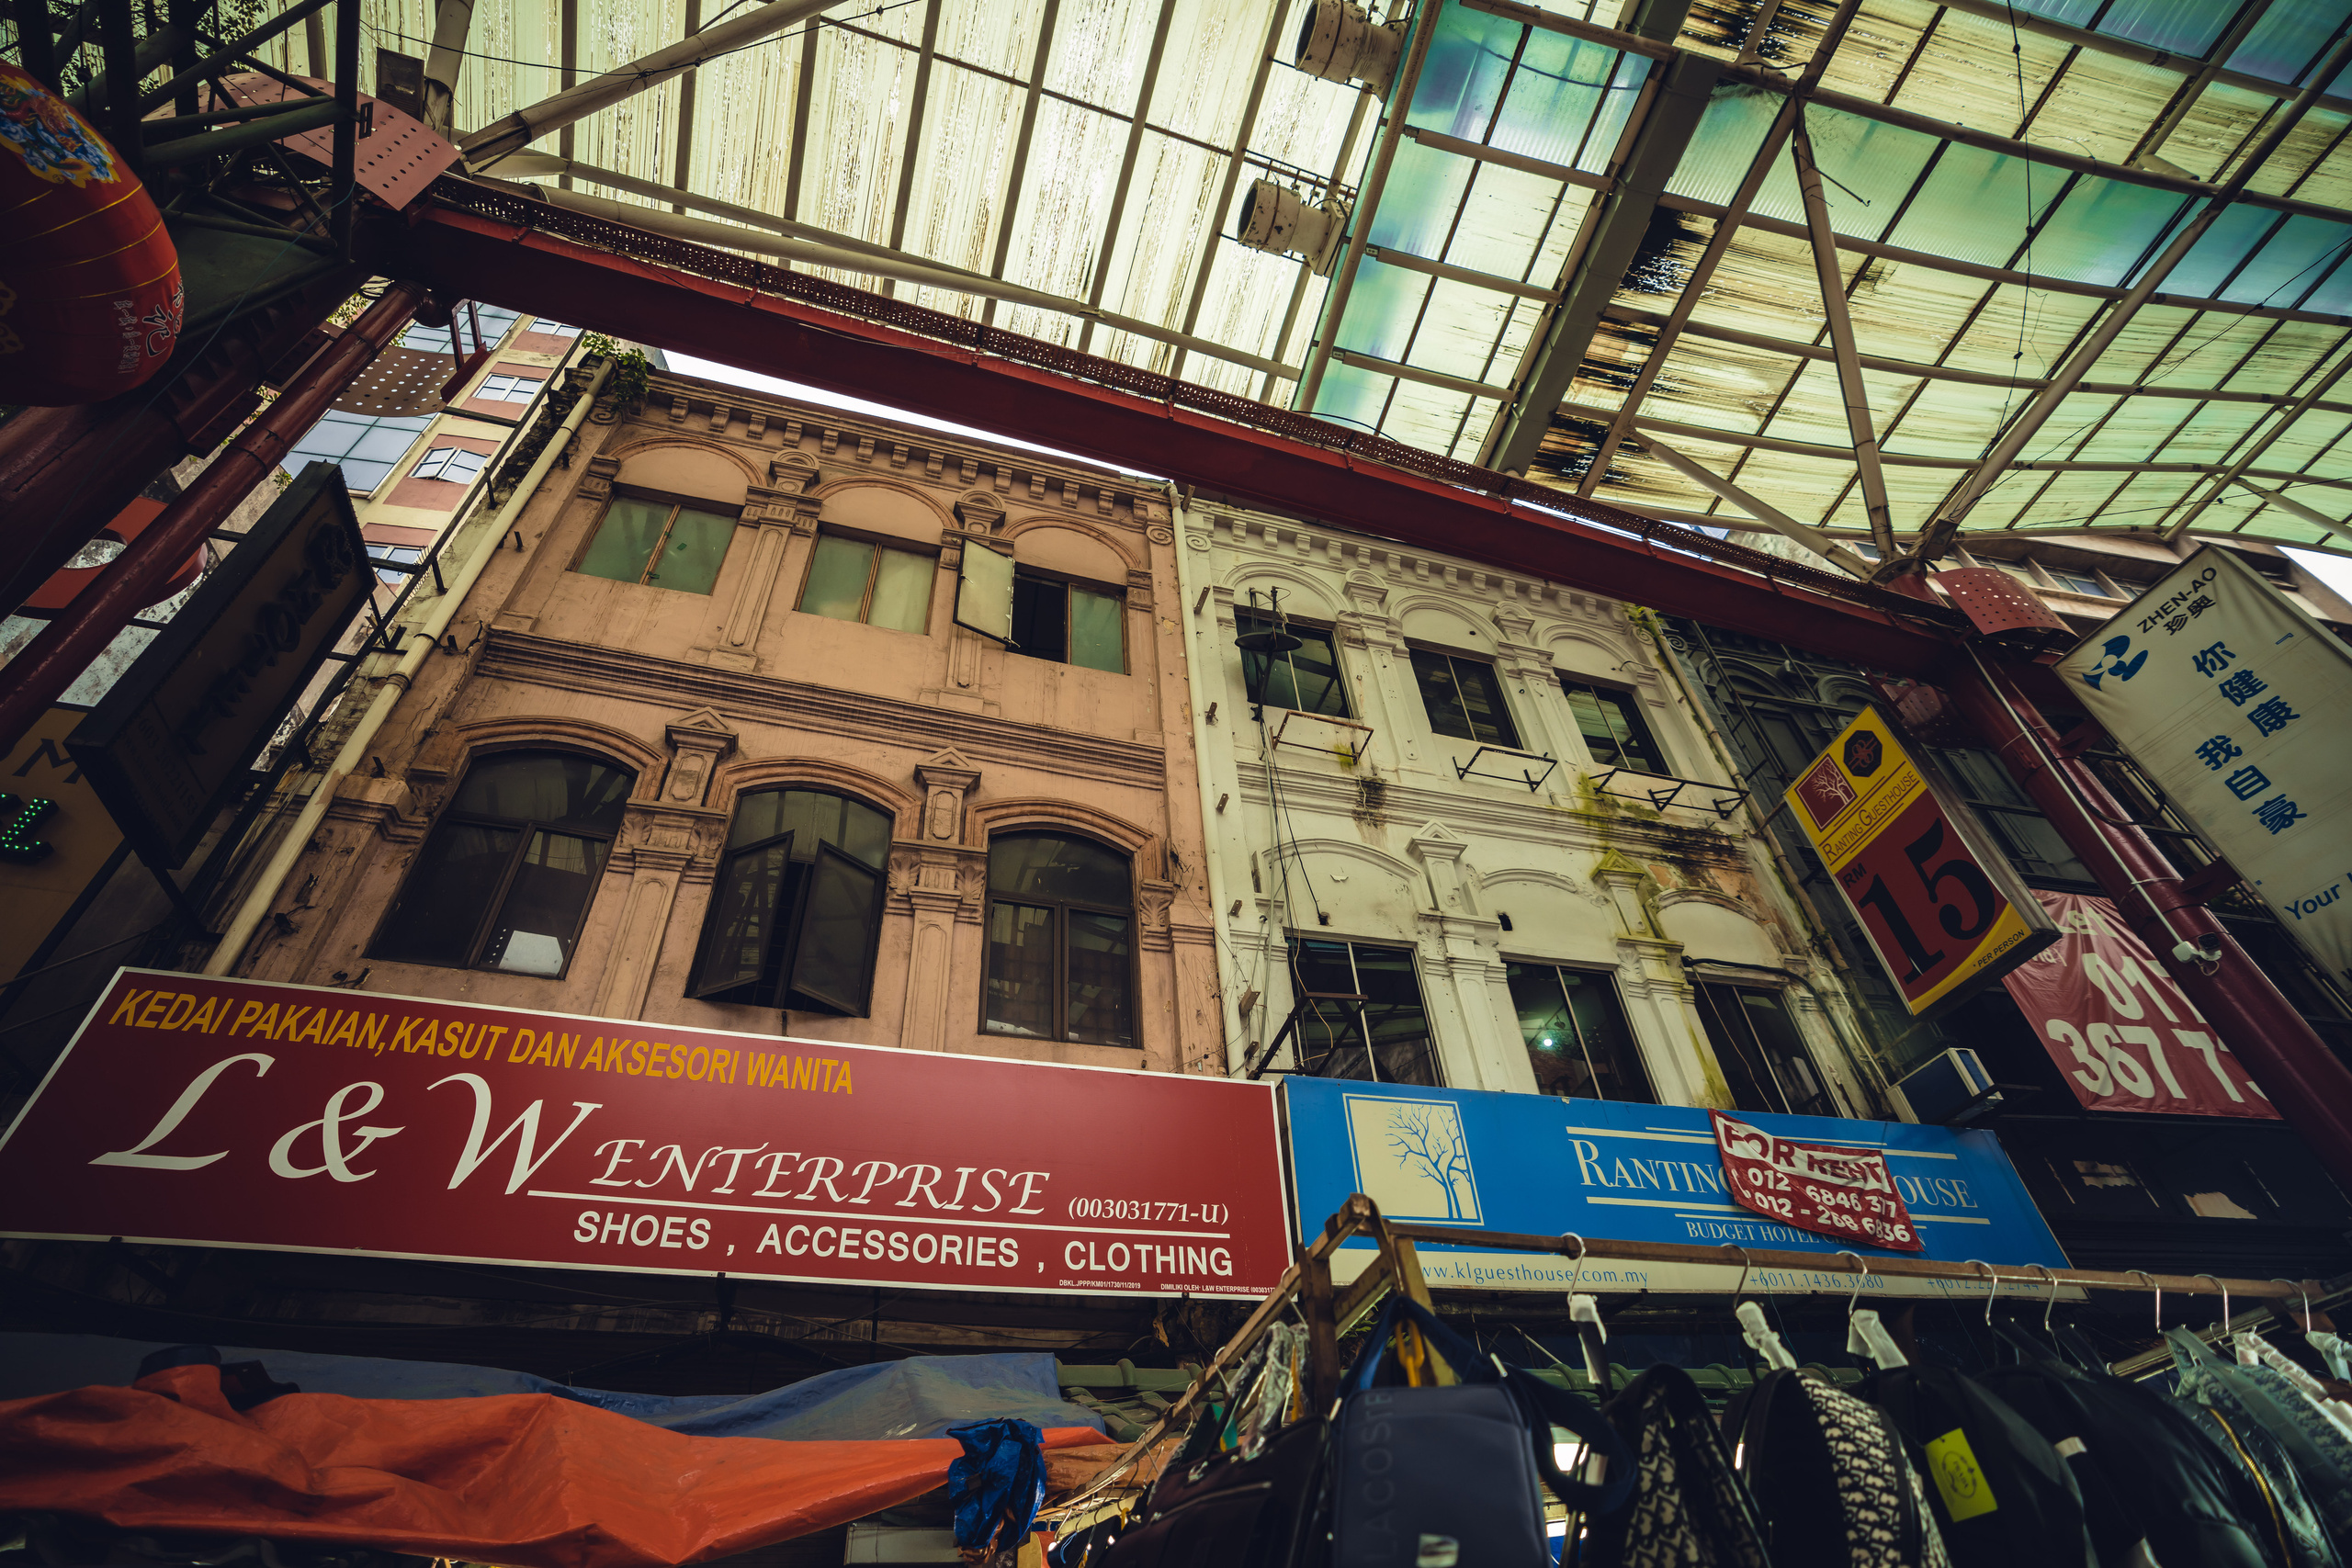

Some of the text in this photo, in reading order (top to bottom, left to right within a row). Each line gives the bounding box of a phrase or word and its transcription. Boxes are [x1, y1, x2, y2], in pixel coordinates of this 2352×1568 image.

[2136, 567, 2217, 634] ZHEN-AO
[2163, 594, 2216, 636] 珍奧
[1822, 770, 1917, 862] RANTING GUESTHOUSE
[1842, 817, 1996, 986] RM 15
[2284, 884, 2340, 920] Your
[1977, 929, 2025, 967] PER PERSON
[107, 988, 234, 1034] KEDAI
[507, 1028, 582, 1069] DAN
[579, 1036, 741, 1084] AKSESORI
[747, 1051, 853, 1095] WANITA
[2045, 1018, 2156, 1100] 367
[88, 1052, 276, 1171] L
[268, 1080, 406, 1183] &
[426, 1072, 604, 1196] W
[588, 1139, 1050, 1216] ENTERPRISE
[1724, 1122, 1883, 1185] FOR RENT
[1747, 1167, 1792, 1192] 012
[1805, 1185, 1862, 1212] 6846
[1754, 1191, 1793, 1218] 012
[1816, 1205, 1860, 1232] 268
[573, 1210, 711, 1250] SHOES
[755, 1223, 1019, 1268] ACCESSORIES
[1064, 1240, 1233, 1277] CLOTHING
[1685, 1221, 1755, 1241] BUDGET
[1758, 1225, 1820, 1244] HOTEL
[1216, 1285, 1250, 1293] ENTERPRISE
[1421, 1261, 1648, 1287] ww.klguesthouse.com.my
